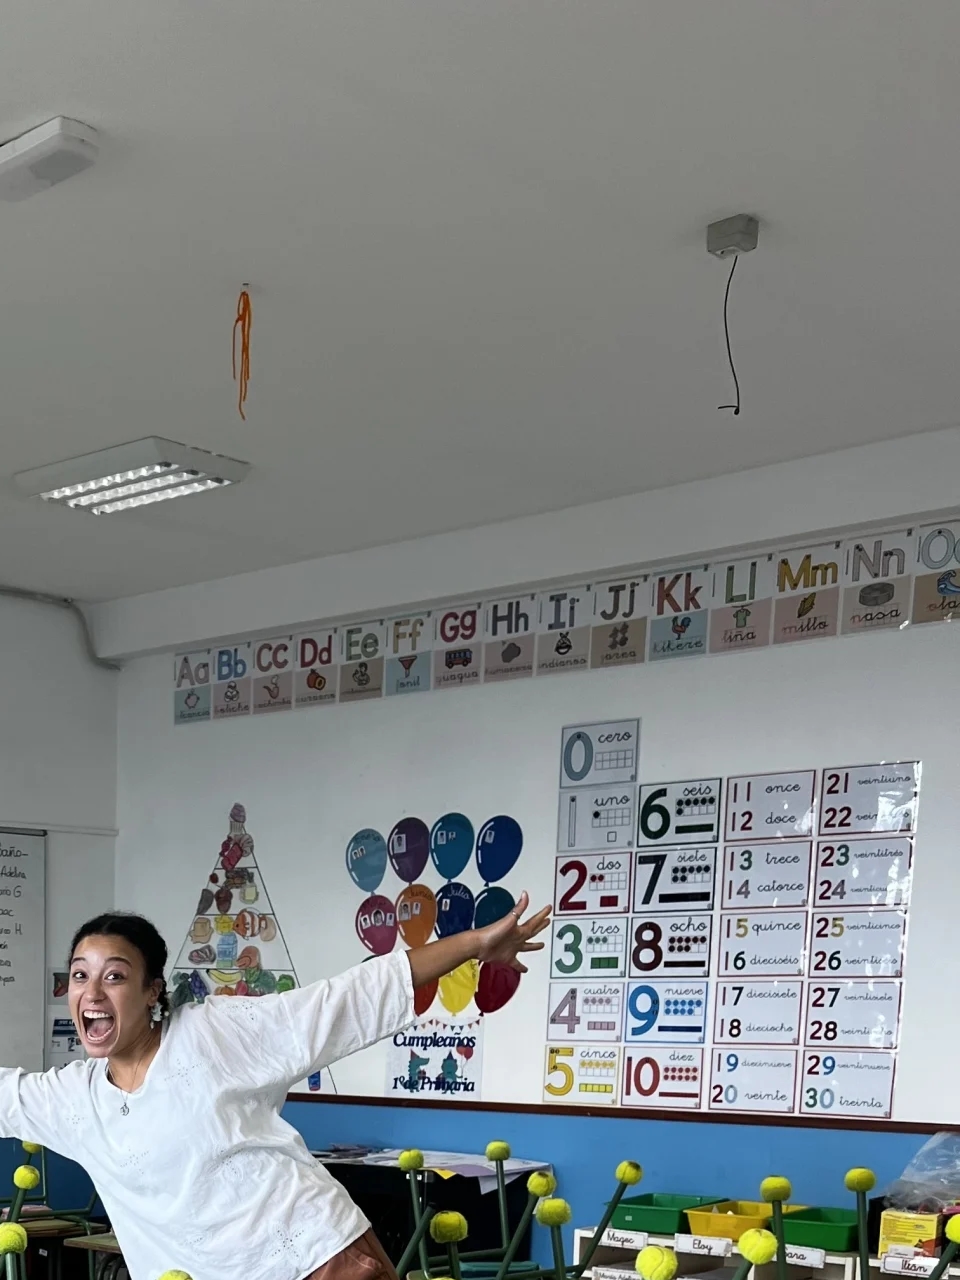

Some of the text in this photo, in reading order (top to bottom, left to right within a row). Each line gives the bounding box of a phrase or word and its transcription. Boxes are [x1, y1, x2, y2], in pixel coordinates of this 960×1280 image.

[921, 528, 960, 569] O
[852, 540, 905, 582] Nn
[725, 562, 757, 604] Ll
[778, 554, 838, 592] Mm
[600, 582, 638, 620] Jj
[657, 572, 703, 615] Kk
[492, 600, 528, 636] Hh
[548, 593, 577, 630] Ii
[851, 608, 902, 623] nasa
[393, 618, 424, 653] Ff
[440, 610, 476, 643] Gg
[782, 616, 828, 633] millo
[346, 627, 379, 661] Ee
[723, 630, 756, 643] liña
[256, 643, 288, 672] Cc
[300, 635, 332, 668] Dd
[177, 656, 210, 688] Aa
[218, 648, 247, 681] Bb
[564, 731, 632, 781] 0 cero
[733, 782, 801, 803] 11 once
[826, 772, 911, 795] 21 veintiuno
[594, 795, 630, 806] uno
[641, 783, 712, 839] 6 seis
[732, 811, 797, 831] 12 doce
[824, 806, 852, 828] 22
[730, 849, 800, 871] 13 trece
[820, 844, 850, 867] 23
[559, 856, 621, 911] 2 dos
[638, 850, 707, 905] 7 siete
[13, 885, 22, 898] G
[448, 885, 470, 900] Julio
[728, 879, 804, 900] 14 catorce
[819, 879, 846, 900] 24
[15, 922, 23, 935] H
[727, 918, 801, 938] 15 quince
[816, 917, 900, 938] 25 veinticinco
[554, 921, 620, 974] 3 tres
[632, 916, 707, 971] 8 ocho
[725, 951, 799, 971] 16 dieciséis
[814, 950, 841, 971] 26
[722, 986, 797, 1006] 17 diecisiete
[811, 987, 840, 1007] 27
[550, 985, 619, 1033] 4 cuatro
[629, 985, 704, 1036] 9 nueve
[720, 1018, 793, 1038] 18 dieciocho
[810, 1020, 838, 1041] 28
[393, 1032, 476, 1051] Cumpleaños
[545, 1047, 616, 1096] 5 cinco
[625, 1050, 695, 1096] 10 diez
[717, 1053, 792, 1072] 19 diecinueve
[806, 1055, 890, 1075] 29 veintinueve
[420, 1076, 475, 1092] Primaria
[712, 1084, 787, 1104] 20 veinte
[805, 1087, 883, 1109] 30 treinta
[693, 1239, 713, 1254] Eloy
